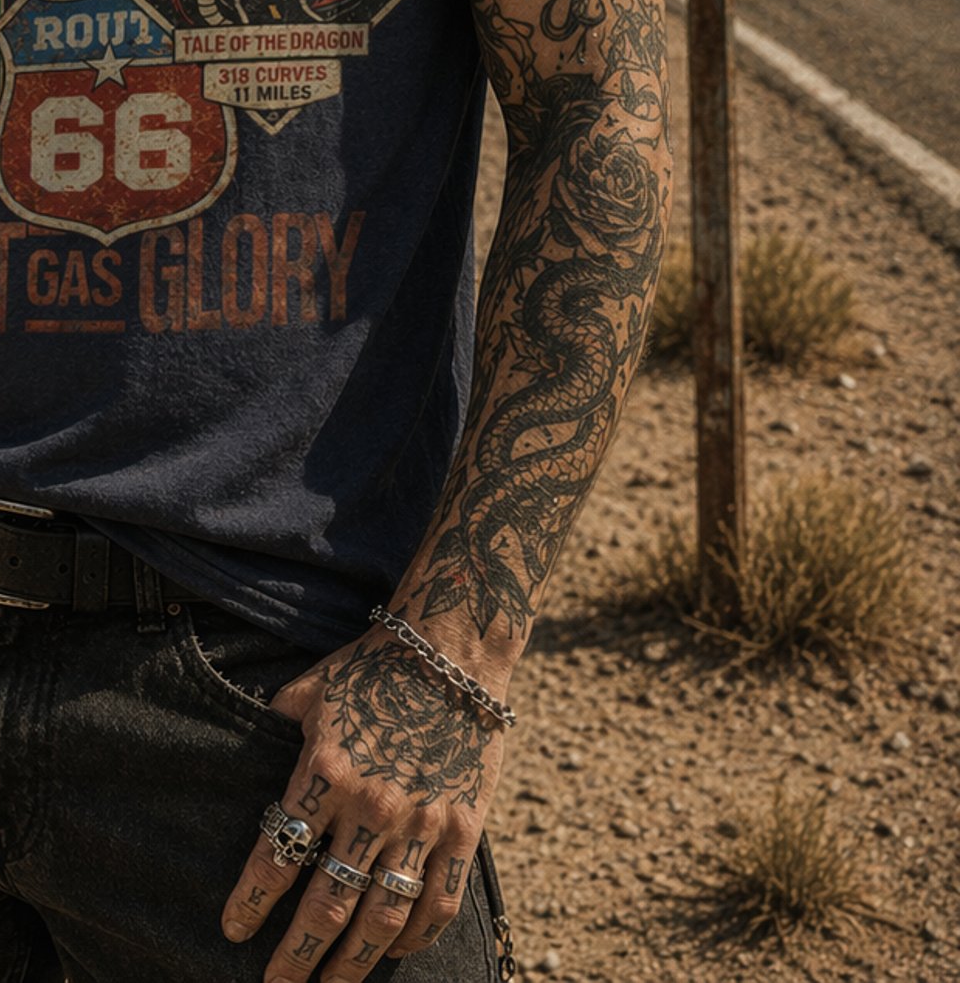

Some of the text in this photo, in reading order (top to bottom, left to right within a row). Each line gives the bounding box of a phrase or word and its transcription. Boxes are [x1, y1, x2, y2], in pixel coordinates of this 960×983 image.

[33, 10, 173, 51] ROUT
[181, 30, 364, 54] TALE OF THE DRAGON
[219, 65, 327, 85] 318 CURVES
[233, 85, 312, 103] 11 MILES
[30, 93, 193, 193] 66
[27, 248, 123, 307] GAS
[140, 211, 367, 335] GLORY
